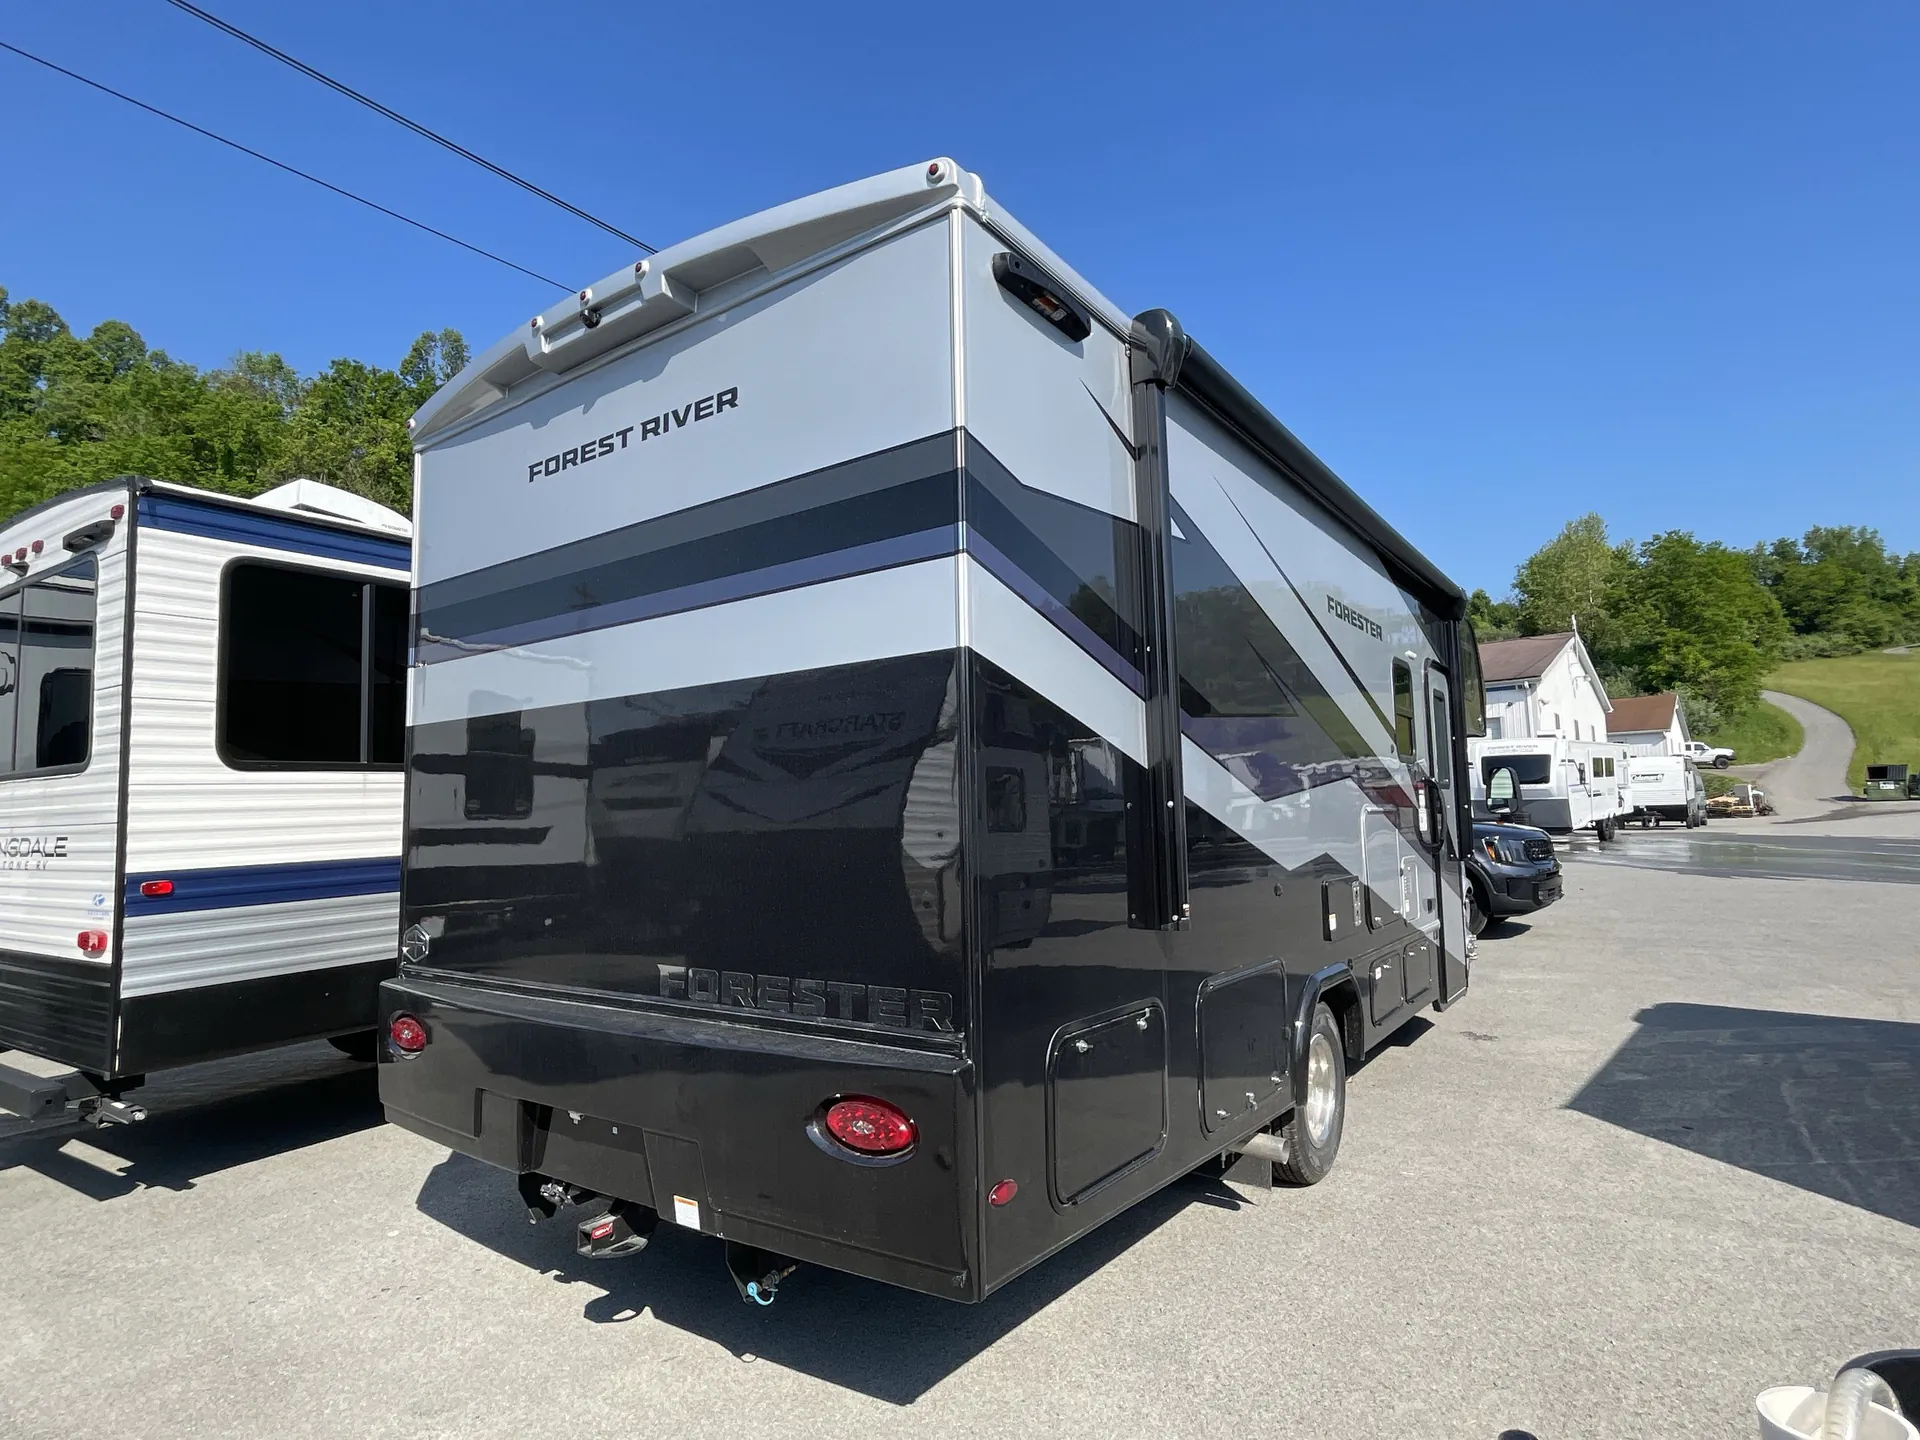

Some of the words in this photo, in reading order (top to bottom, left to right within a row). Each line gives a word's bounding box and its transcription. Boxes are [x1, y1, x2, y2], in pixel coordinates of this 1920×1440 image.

[528, 426, 635, 483] FOREST
[640, 386, 739, 442] RIVER
[1326, 594, 1383, 642] FORESTER
[656, 963, 955, 1032] FORESTER
